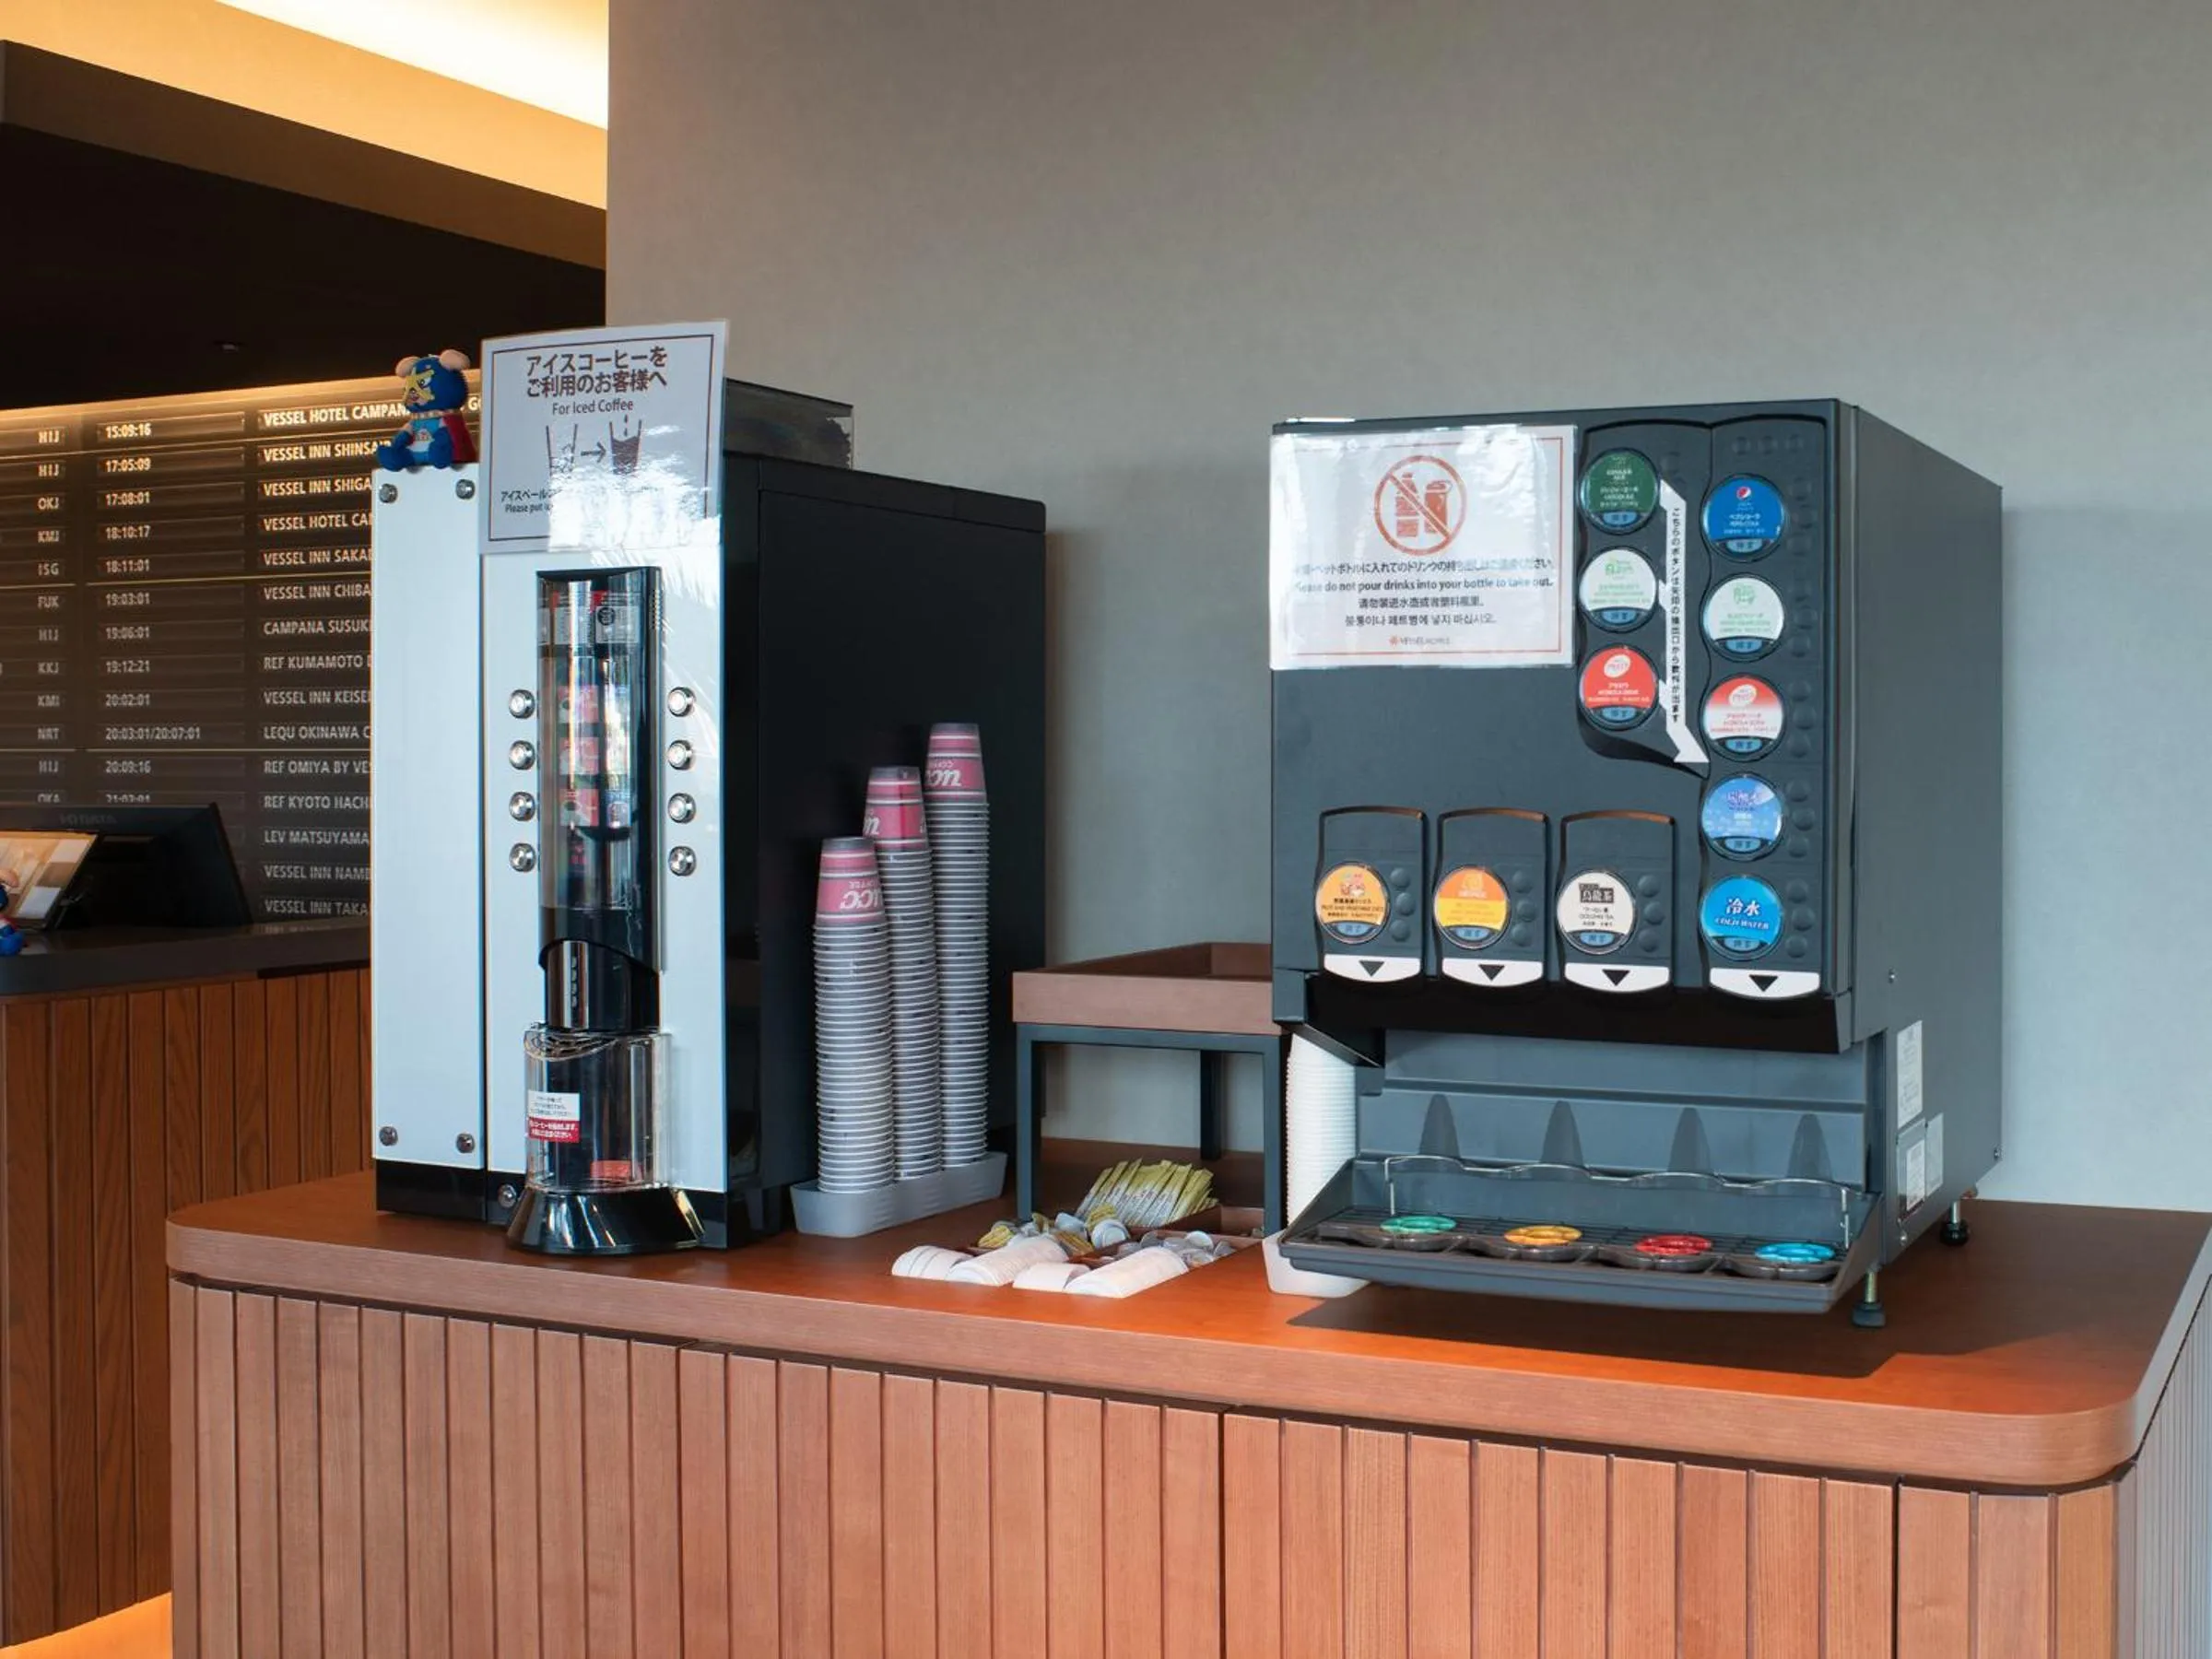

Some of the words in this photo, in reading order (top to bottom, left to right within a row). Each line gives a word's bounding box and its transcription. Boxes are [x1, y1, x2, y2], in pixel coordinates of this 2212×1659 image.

[526, 346, 667, 377] アイスコーヒーを
[526, 370, 667, 398] ご利用のお客様へ
[264, 412, 306, 427] VESSEL
[310, 407, 348, 423] HOTEL
[352, 402, 410, 420] CAMPAN
[553, 403, 571, 415] For
[572, 401, 595, 414] Iced
[598, 398, 634, 412] Coffee
[264, 446, 305, 462] VESSEL
[309, 443, 331, 459] INN
[264, 481, 305, 496] VESSEL
[309, 478, 331, 494] INN
[334, 477, 371, 493] SHIGA
[505, 503, 528, 513] Please
[264, 516, 305, 532] VESSEL
[309, 513, 349, 529] HOTEL
[264, 550, 305, 566] VESSEL
[309, 548, 331, 564] INN
[264, 584, 305, 600] VESSEL
[309, 582, 331, 598] INN
[334, 582, 371, 598] CHIBA
[1324, 582, 1338, 592] do
[1339, 582, 1356, 592] not
[1358, 582, 1382, 594] pour
[1383, 579, 1415, 591] drinks
[1417, 579, 1437, 590] into
[1439, 581, 1462, 592] your
[1464, 578, 1494, 589] bottle
[1496, 579, 1506, 588] to
[264, 619, 325, 635] CAMPANA
[328, 618, 371, 634] SUSUK
[264, 655, 285, 670] REF
[288, 654, 364, 670] KUMAMOTO
[264, 690, 306, 705] VESSEL
[309, 690, 331, 705] INN
[264, 725, 295, 742] LEQU
[298, 725, 359, 740] OKINAWA
[264, 759, 285, 774] REF
[288, 759, 330, 774] OMIYA
[333, 759, 353, 775] BY
[264, 795, 285, 809] REF
[288, 795, 331, 809] KYOTO
[265, 830, 288, 845] LEV
[289, 830, 371, 846] MATSUYAMA
[265, 865, 307, 879] VESSEL
[310, 865, 332, 880] INN
[265, 900, 307, 915] VESSEL
[311, 900, 332, 915] INN
[1725, 897, 1760, 916] 冷水
